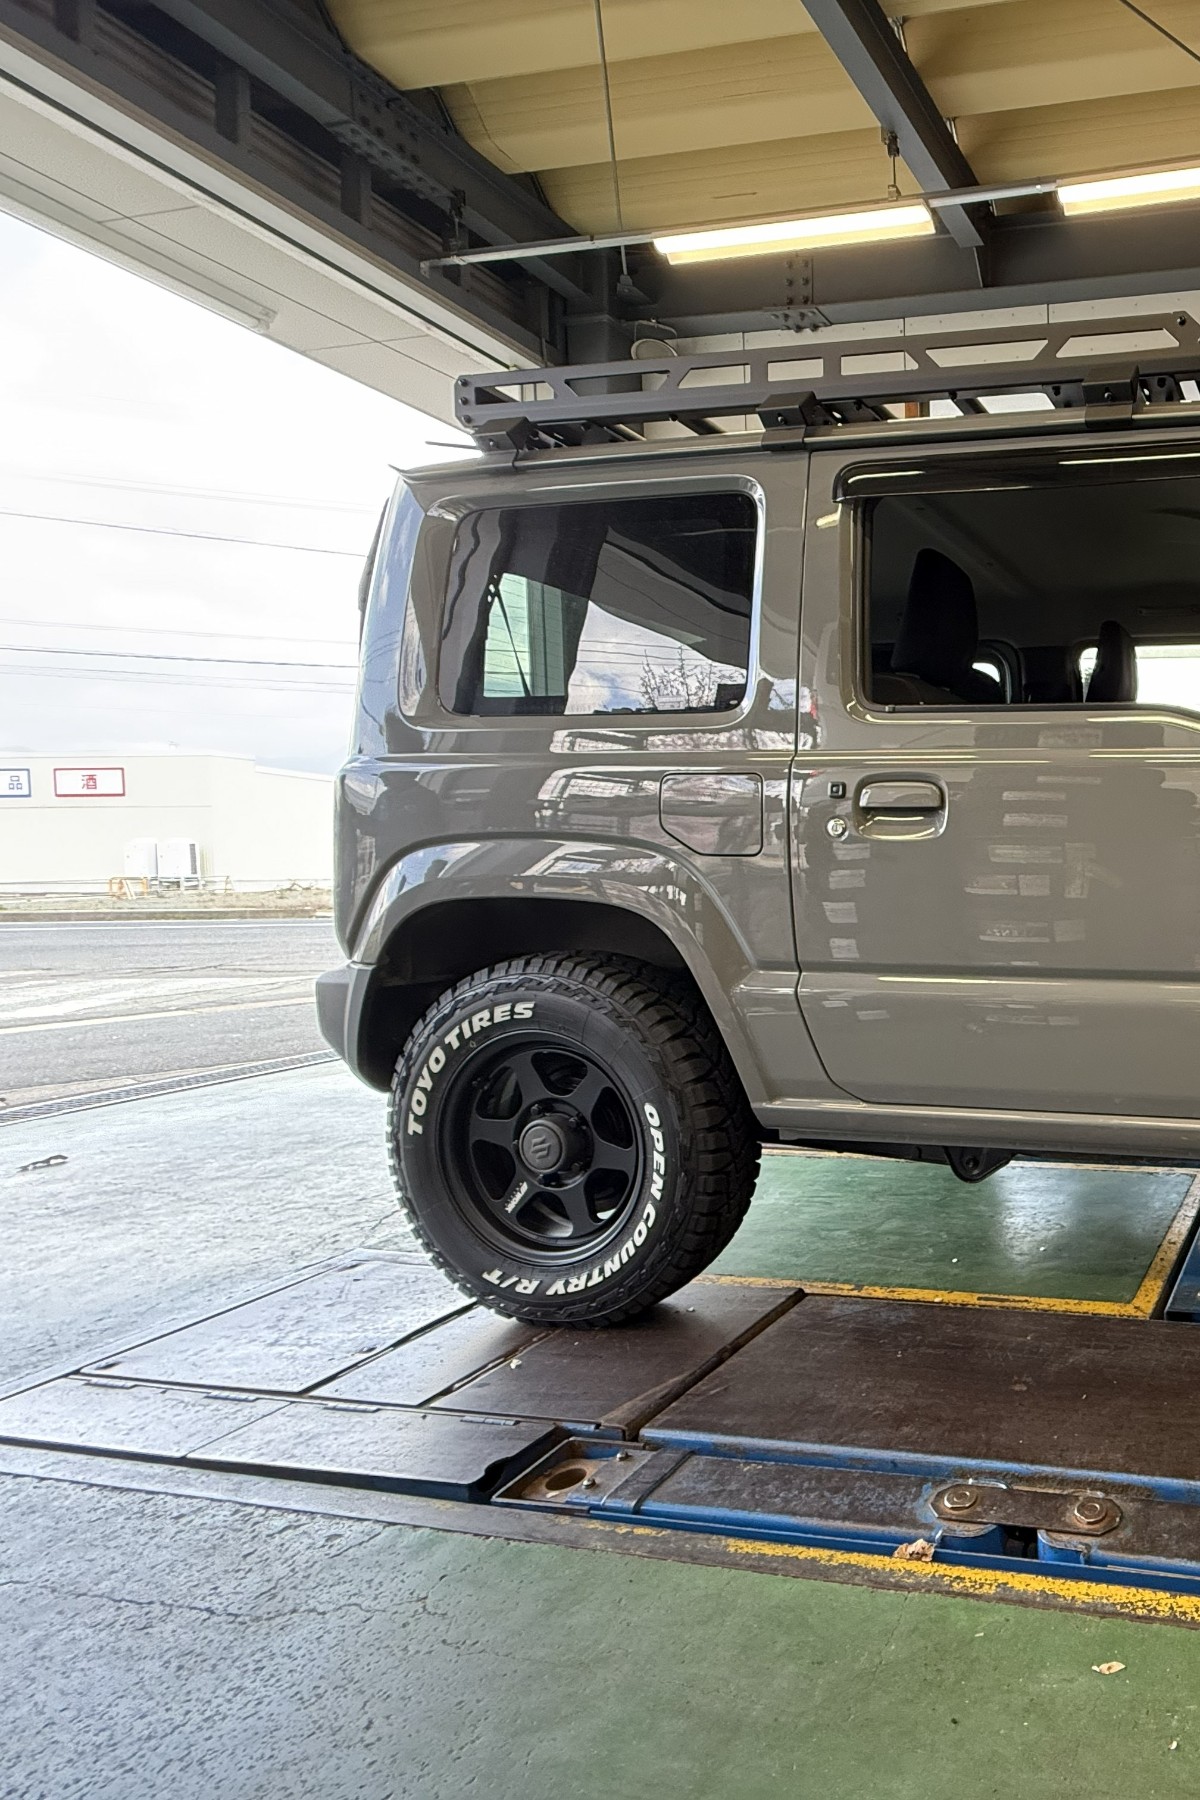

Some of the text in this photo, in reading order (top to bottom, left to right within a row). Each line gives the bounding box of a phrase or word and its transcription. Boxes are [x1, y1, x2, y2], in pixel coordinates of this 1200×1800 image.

[9, 775, 22, 790] 品
[81, 774, 97, 790] 酒
[407, 1001, 535, 1136] TOYO TIRES
[482, 1102, 666, 1296] OPEN COUNTRY R/T
